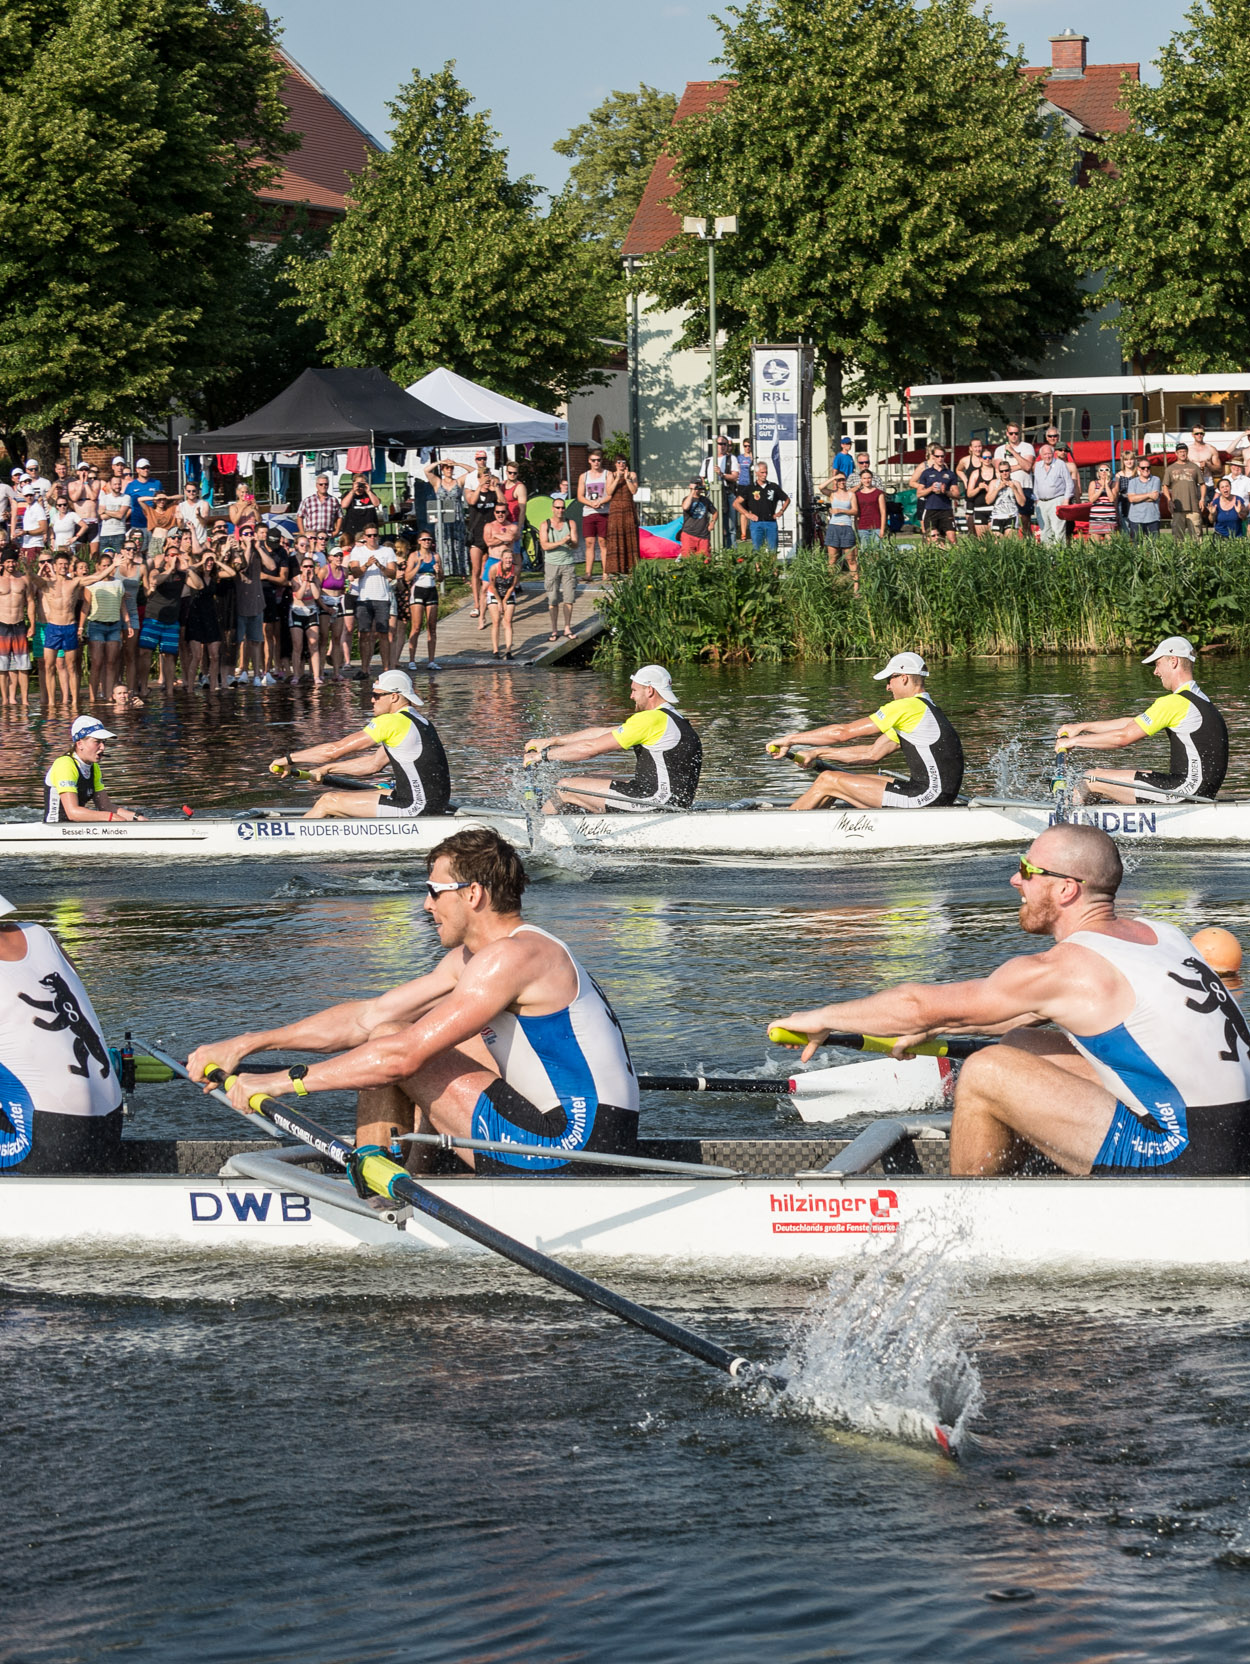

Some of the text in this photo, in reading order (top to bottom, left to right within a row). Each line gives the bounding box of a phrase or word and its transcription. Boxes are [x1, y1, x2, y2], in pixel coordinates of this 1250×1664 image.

[762, 392, 790, 402] RBL
[257, 822, 420, 837] RBL RUDER-BUNDESLIGA
[832, 812, 875, 832] Melitta
[62, 828, 128, 836] Bessel-R.C. Minden
[189, 1192, 312, 1222] DWB
[770, 1194, 867, 1218] hilzinger
[775, 1223, 823, 1232] Deutschlands
[824, 1223, 846, 1233] große
